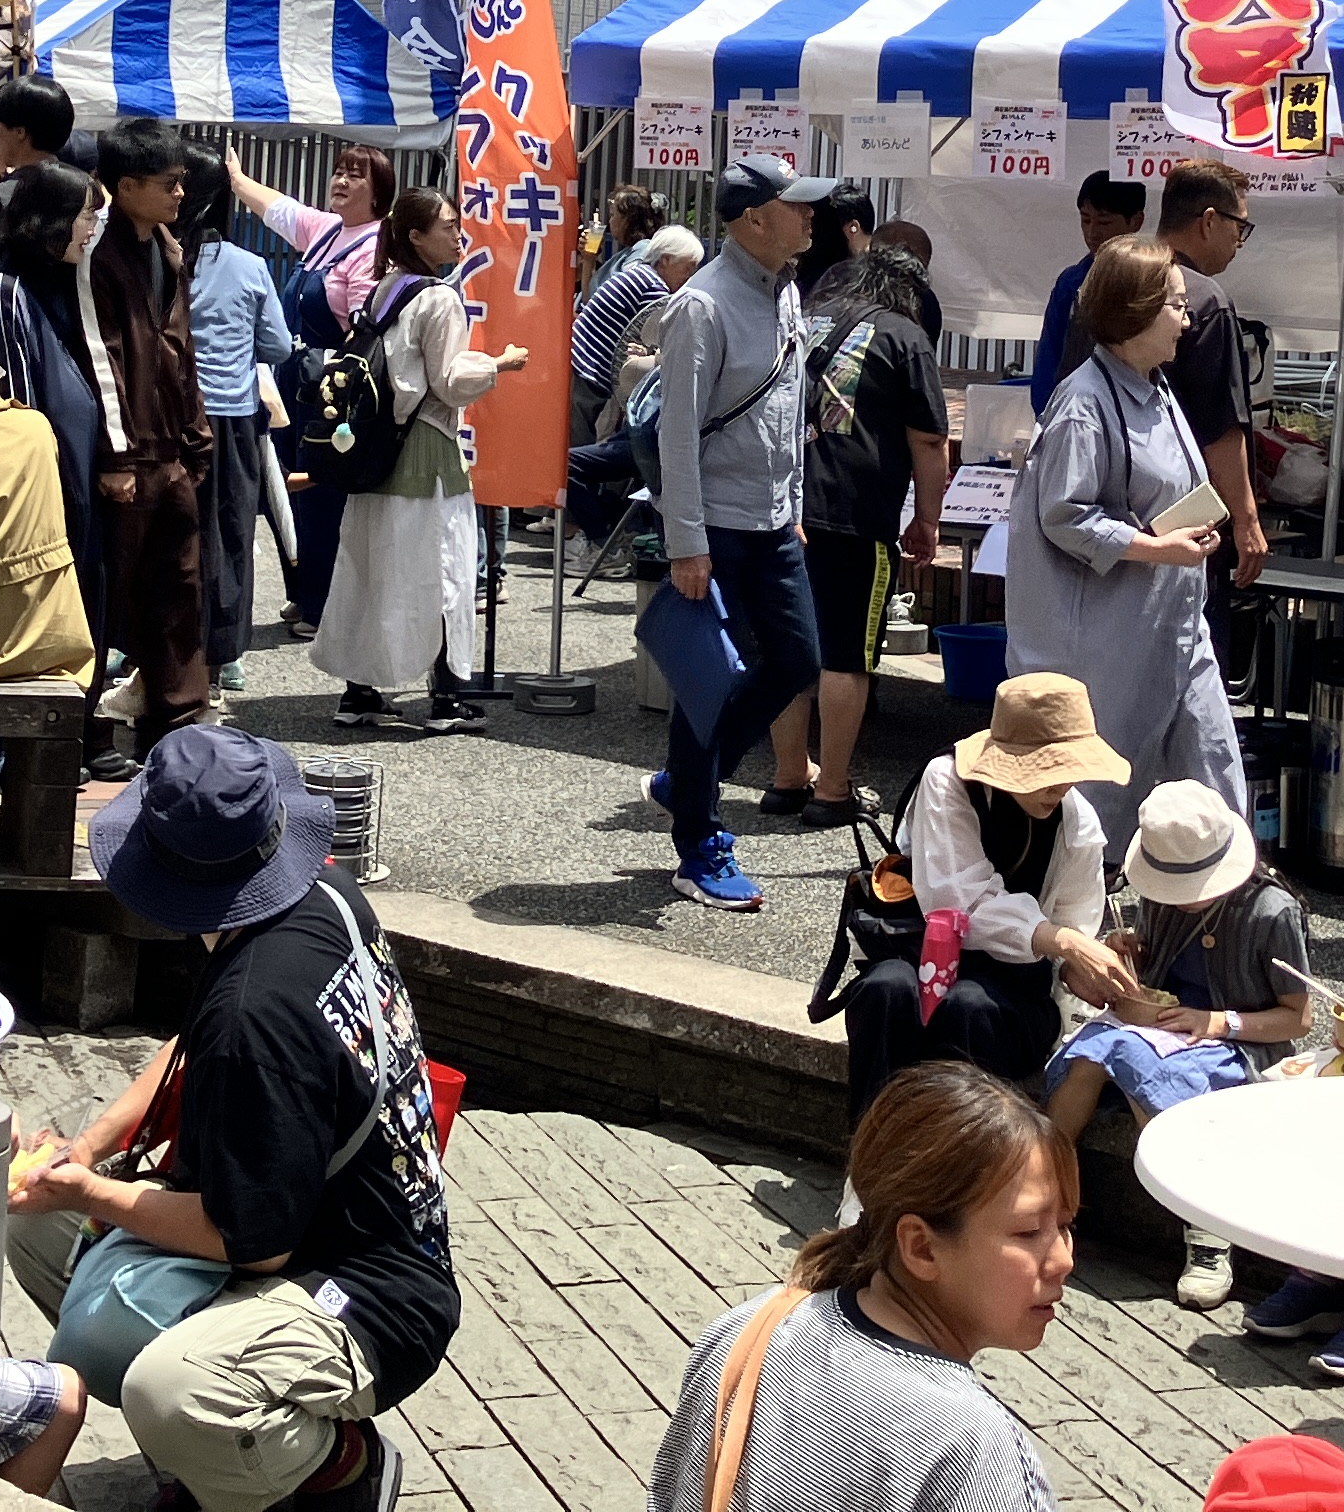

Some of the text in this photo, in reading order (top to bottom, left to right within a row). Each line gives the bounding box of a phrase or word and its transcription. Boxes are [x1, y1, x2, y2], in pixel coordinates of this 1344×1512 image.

[641, 123, 704, 136] シフォンケーキ
[734, 125, 801, 139] シフォンケーキ
[981, 128, 1057, 143] シフォンケーキ
[861, 137, 911, 150] あいらんど
[649, 148, 699, 166] 100円
[990, 155, 1050, 175] 100円
[1127, 158, 1191, 178] 100
[495, 64, 561, 293] クッキー
